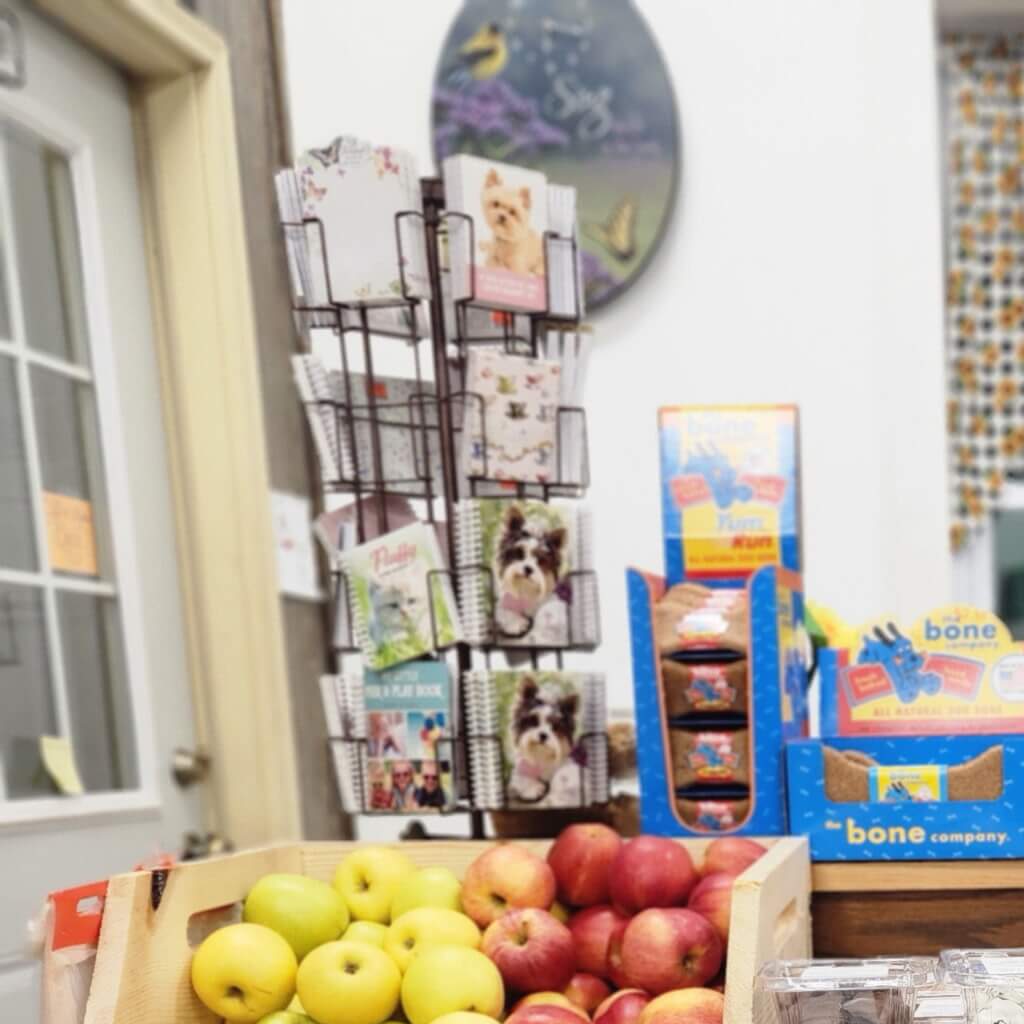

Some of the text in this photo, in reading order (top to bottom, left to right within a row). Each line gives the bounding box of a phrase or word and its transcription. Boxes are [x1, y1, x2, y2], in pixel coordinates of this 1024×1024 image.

[925, 618, 997, 640] bone
[824, 820, 842, 829] the
[847, 818, 926, 844] bone
